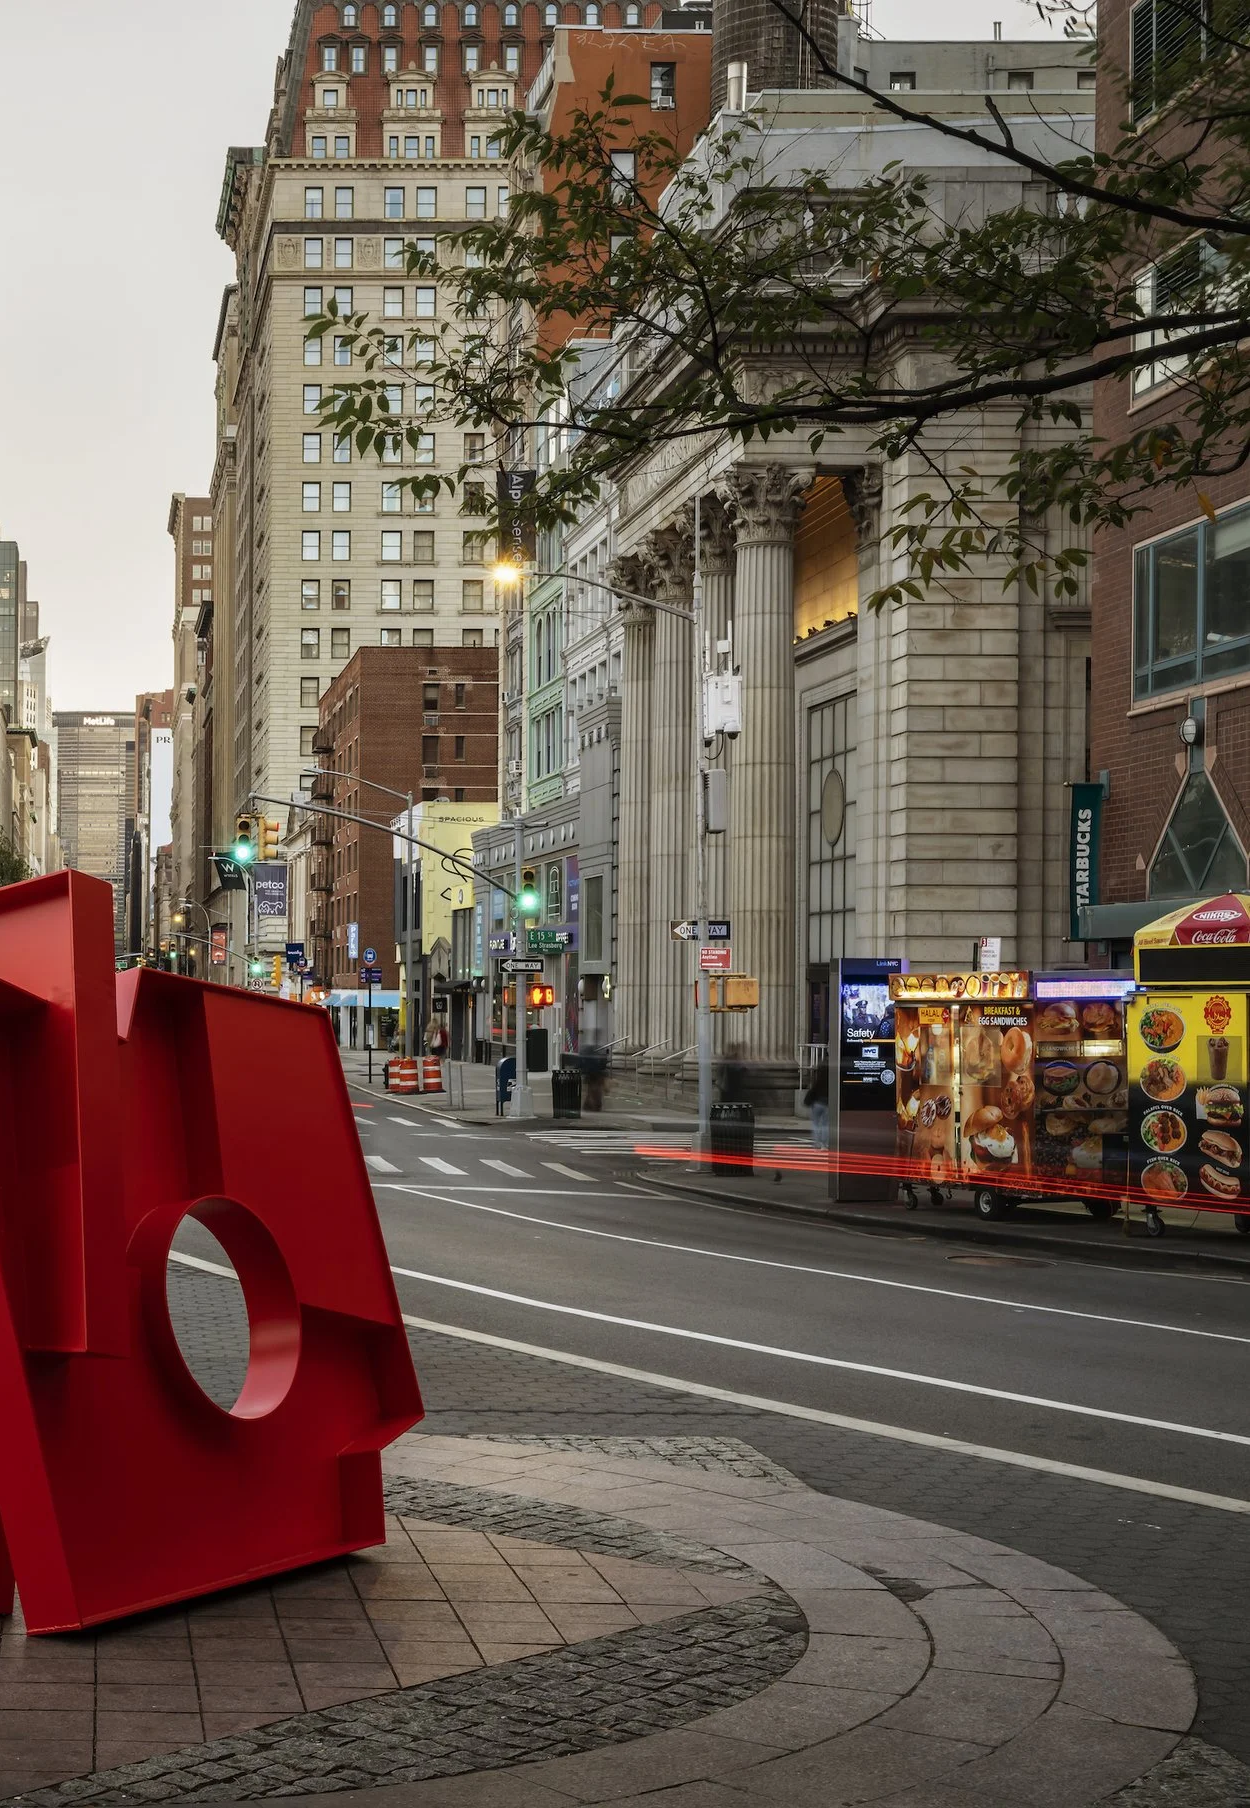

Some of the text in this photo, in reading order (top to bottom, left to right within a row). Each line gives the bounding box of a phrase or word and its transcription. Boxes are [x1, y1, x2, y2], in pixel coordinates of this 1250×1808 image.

[83, 716, 115, 726] MetLife
[221, 863, 234, 873] W
[255, 880, 284, 890] petco
[679, 926, 696, 935] ONE
[530, 931, 534, 941] E
[537, 931, 545, 941] 15
[538, 942, 563, 951] Strasberg
[921, 1009, 940, 1017] HALAL
[984, 1006, 1021, 1015] BREAKFAST &
[978, 1017, 1028, 1026] EGG SANDWICHES
[846, 1028, 875, 1040] Safety
